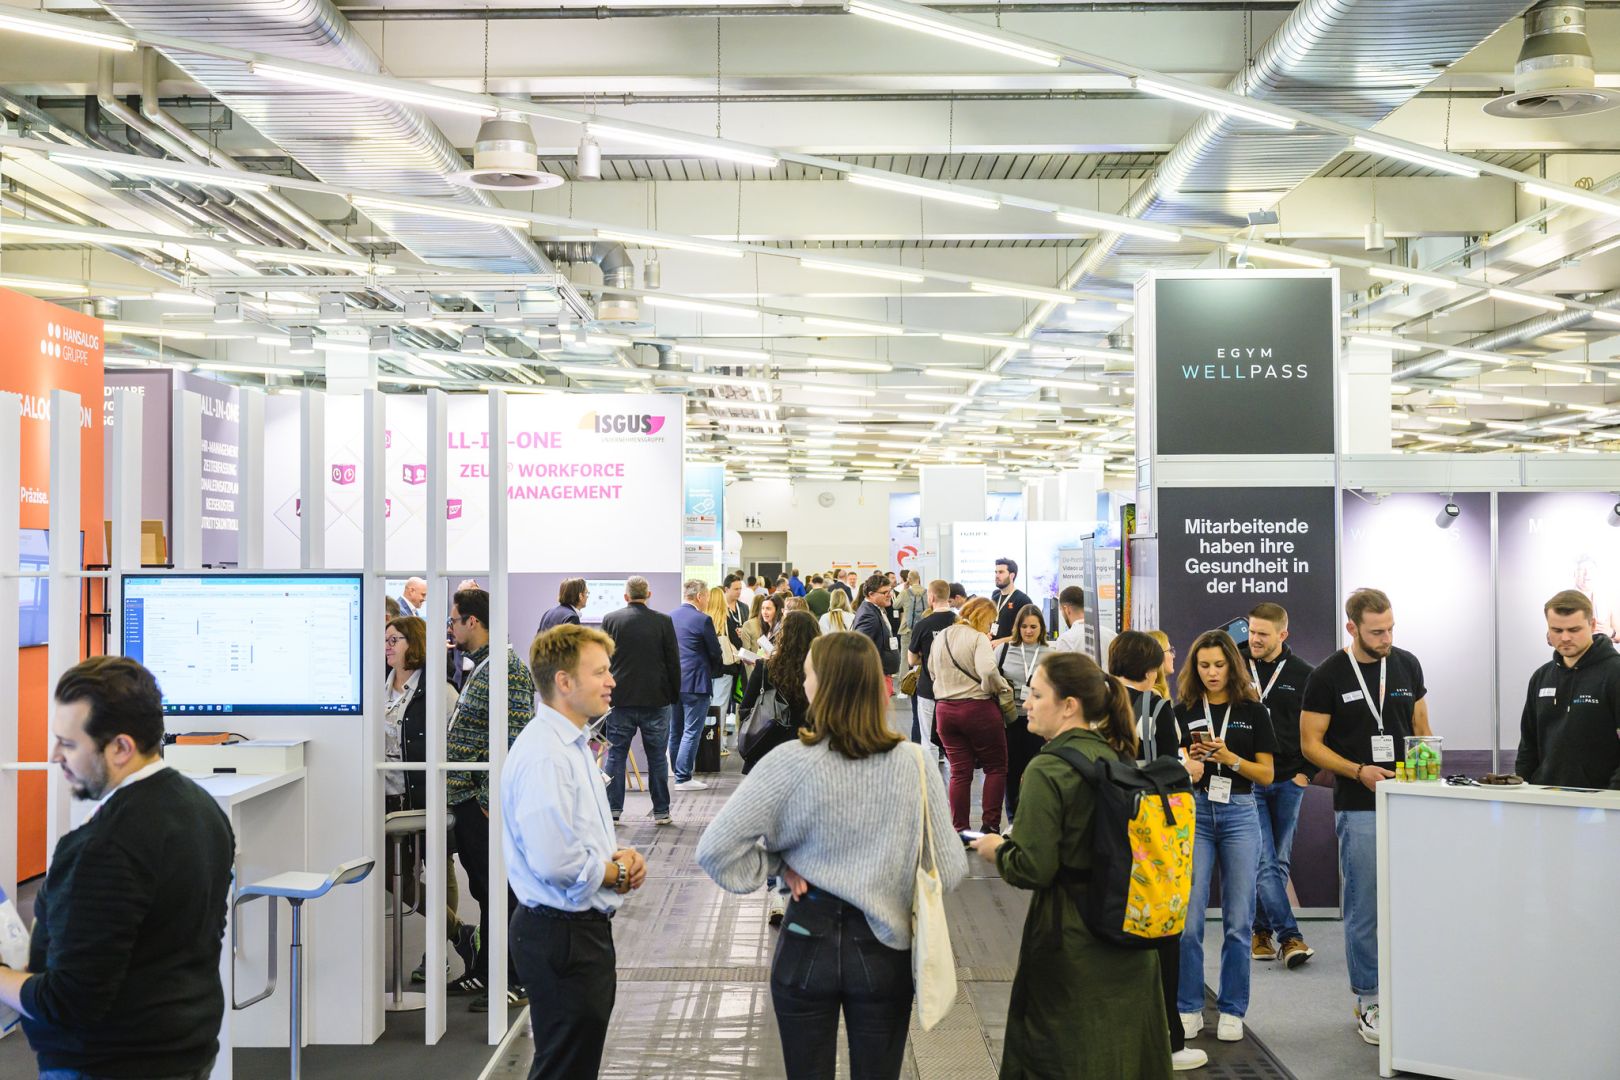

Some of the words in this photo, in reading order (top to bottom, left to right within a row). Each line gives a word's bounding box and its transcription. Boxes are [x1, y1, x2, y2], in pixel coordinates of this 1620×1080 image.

[62, 326, 99, 350] HANSALOG
[62, 345, 88, 366] GRUPPE
[1217, 348, 1272, 358] EGYM
[1181, 364, 1308, 379] WELLPASS
[594, 414, 652, 434] ISGUS
[448, 431, 562, 450] LL-I-ONE
[518, 463, 625, 478] WORKFORCE
[20, 486, 49, 504] Präzise.
[1185, 518, 1309, 534] Mitarbeitende
[1200, 538, 1255, 554] haben
[1260, 538, 1294, 554] ihre
[1185, 558, 1288, 574] Gesundheit
[1293, 558, 1309, 573] in
[1206, 578, 1236, 593] der
[1241, 578, 1288, 593] Hand
